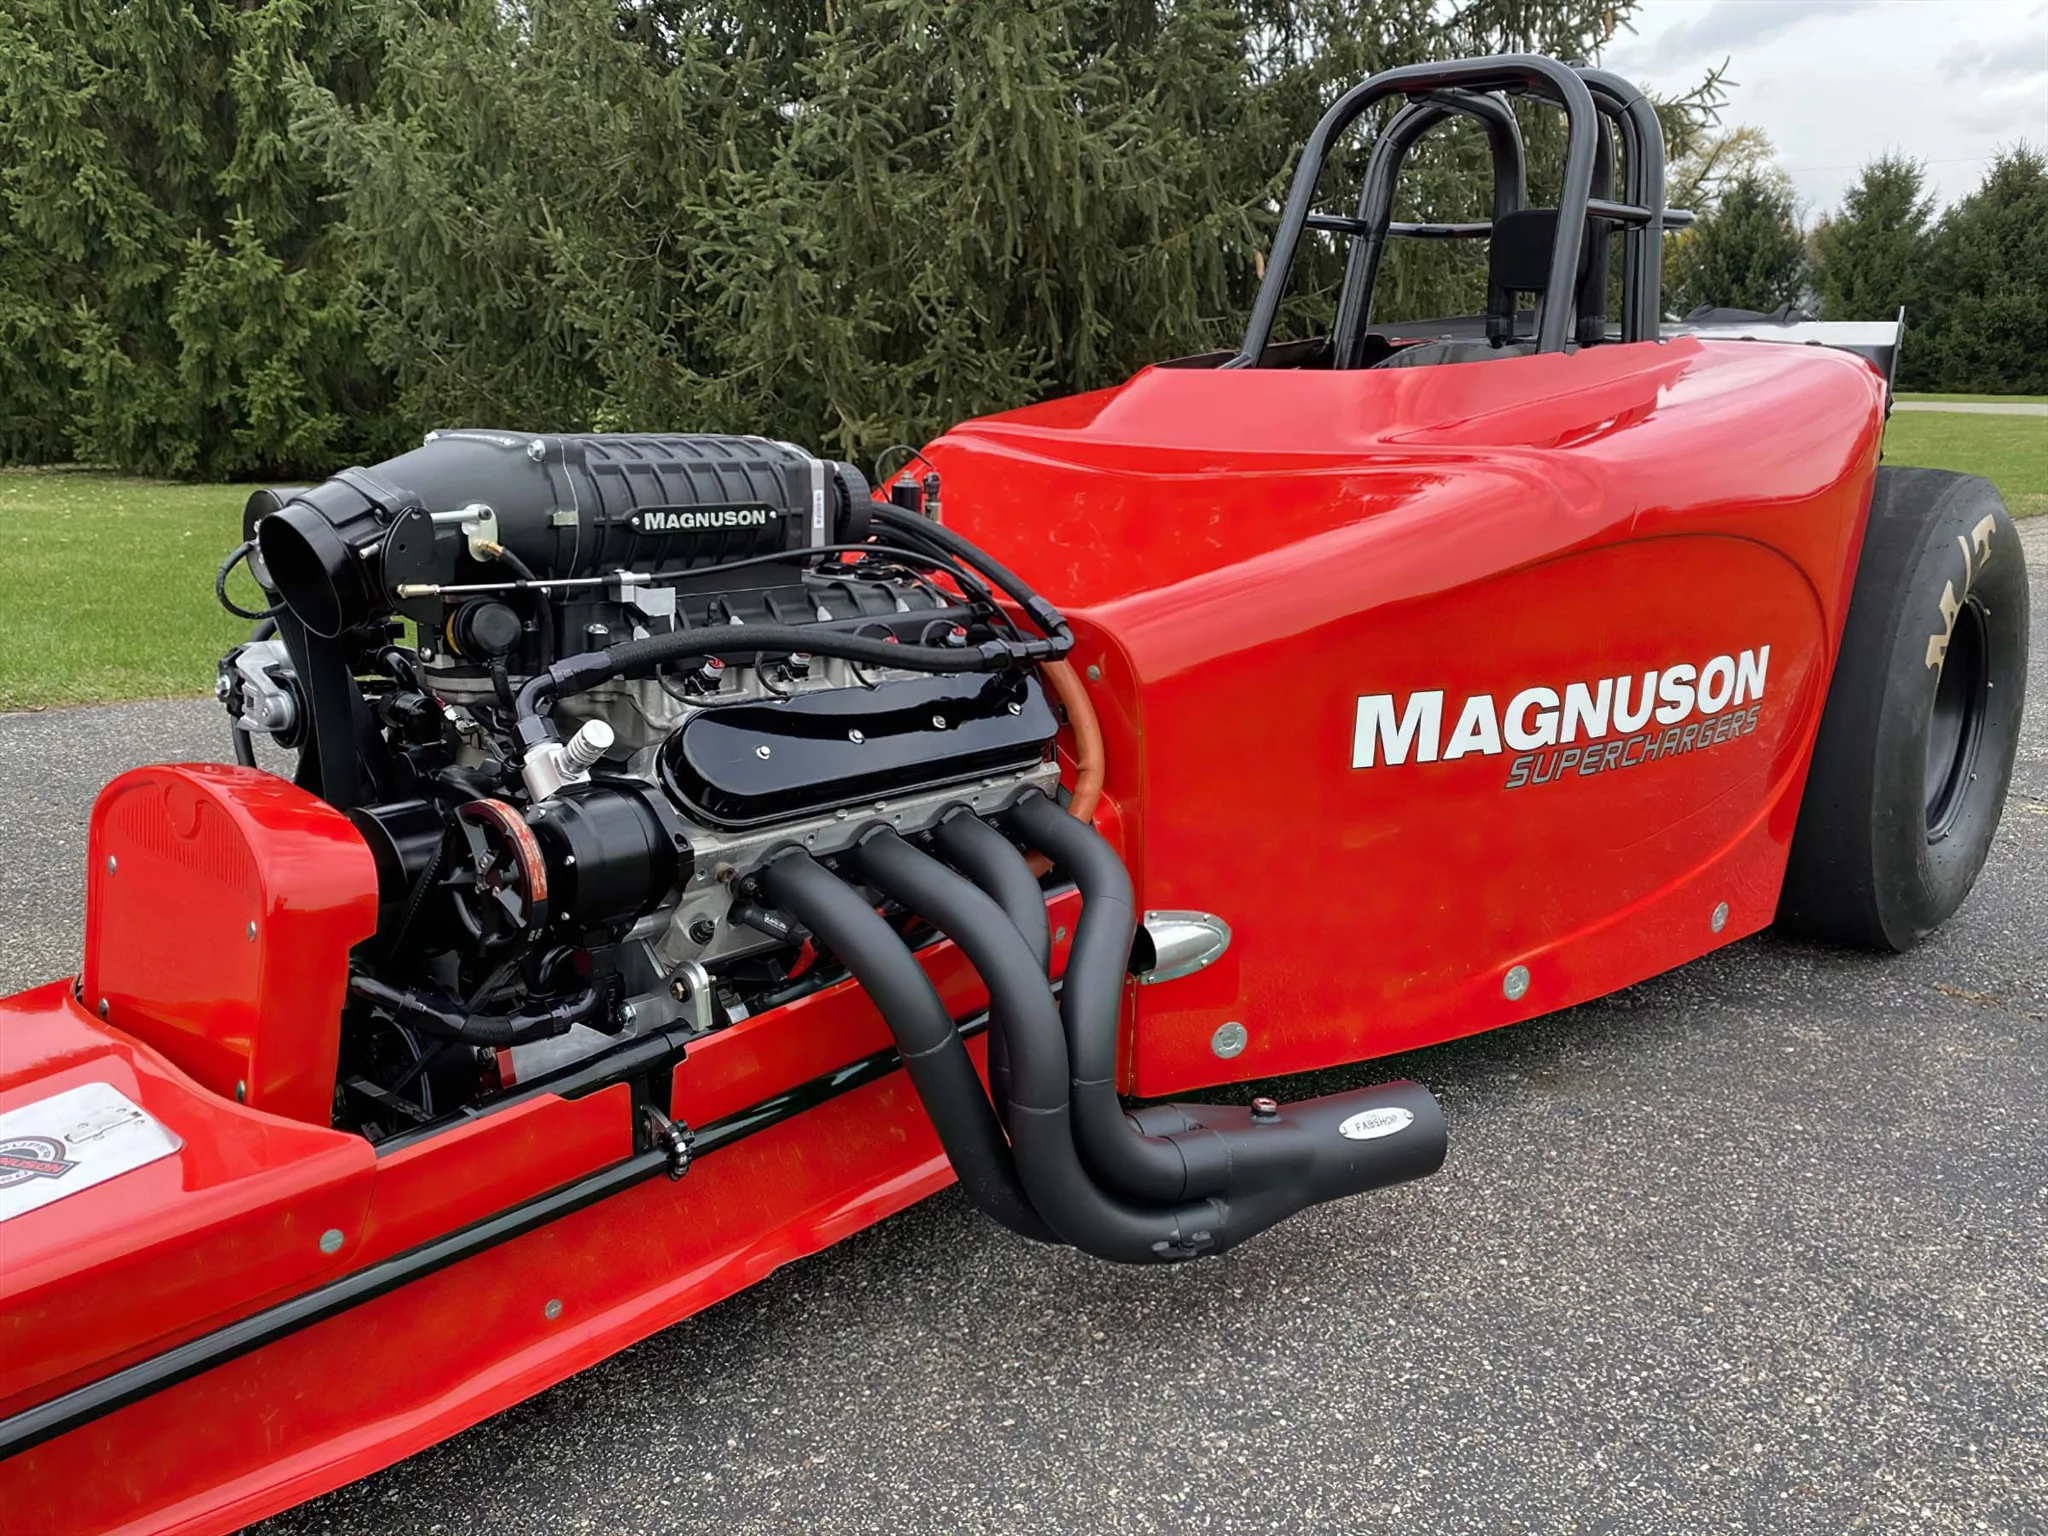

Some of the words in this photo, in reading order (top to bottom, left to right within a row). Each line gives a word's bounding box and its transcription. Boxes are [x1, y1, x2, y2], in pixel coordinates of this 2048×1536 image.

[644, 510, 766, 530] MAGNUSON
[1352, 645, 1770, 768] MAGNUSON
[1506, 705, 1761, 788] SUPERCHARGERS
[1355, 1114, 1398, 1132] FABSHOP
